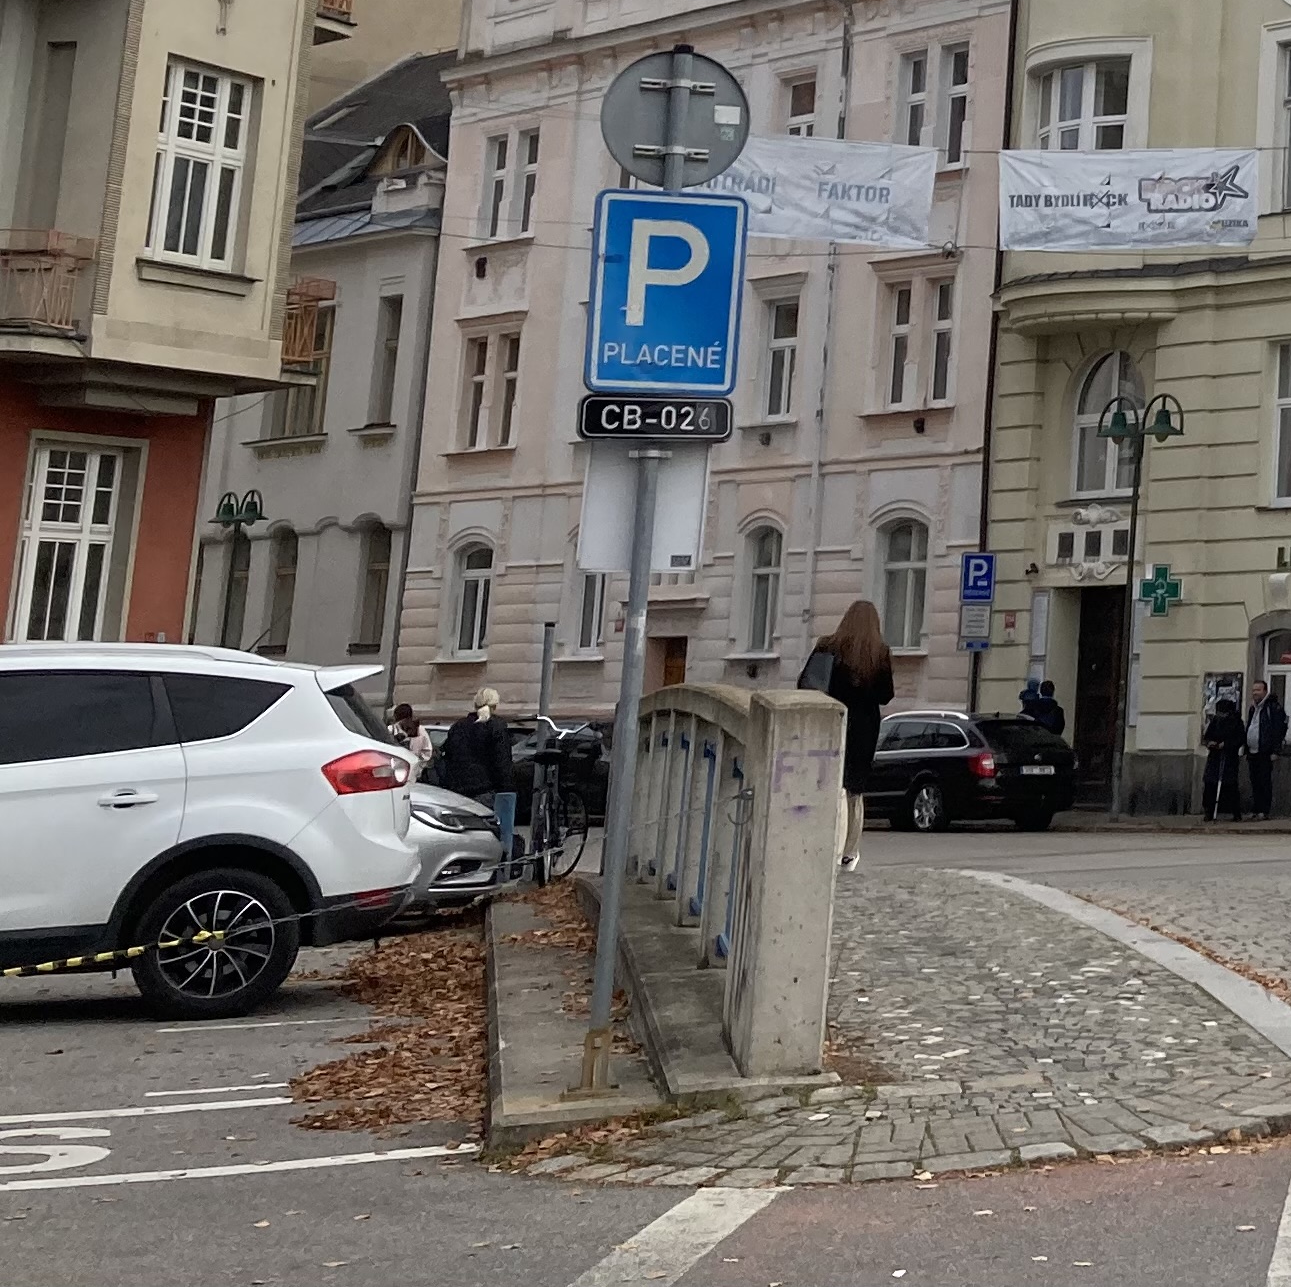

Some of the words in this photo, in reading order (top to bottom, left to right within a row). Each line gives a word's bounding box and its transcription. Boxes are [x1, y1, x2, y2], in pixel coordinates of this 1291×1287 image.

[817, 181, 891, 204] FAKTOR
[1008, 194, 1042, 209] TADY
[1149, 193, 1217, 211] RADIO
[625, 218, 710, 326] P
[603, 341, 723, 369] PLACENÉ
[600, 404, 711, 431] CB-026
[968, 558, 988, 587] P
